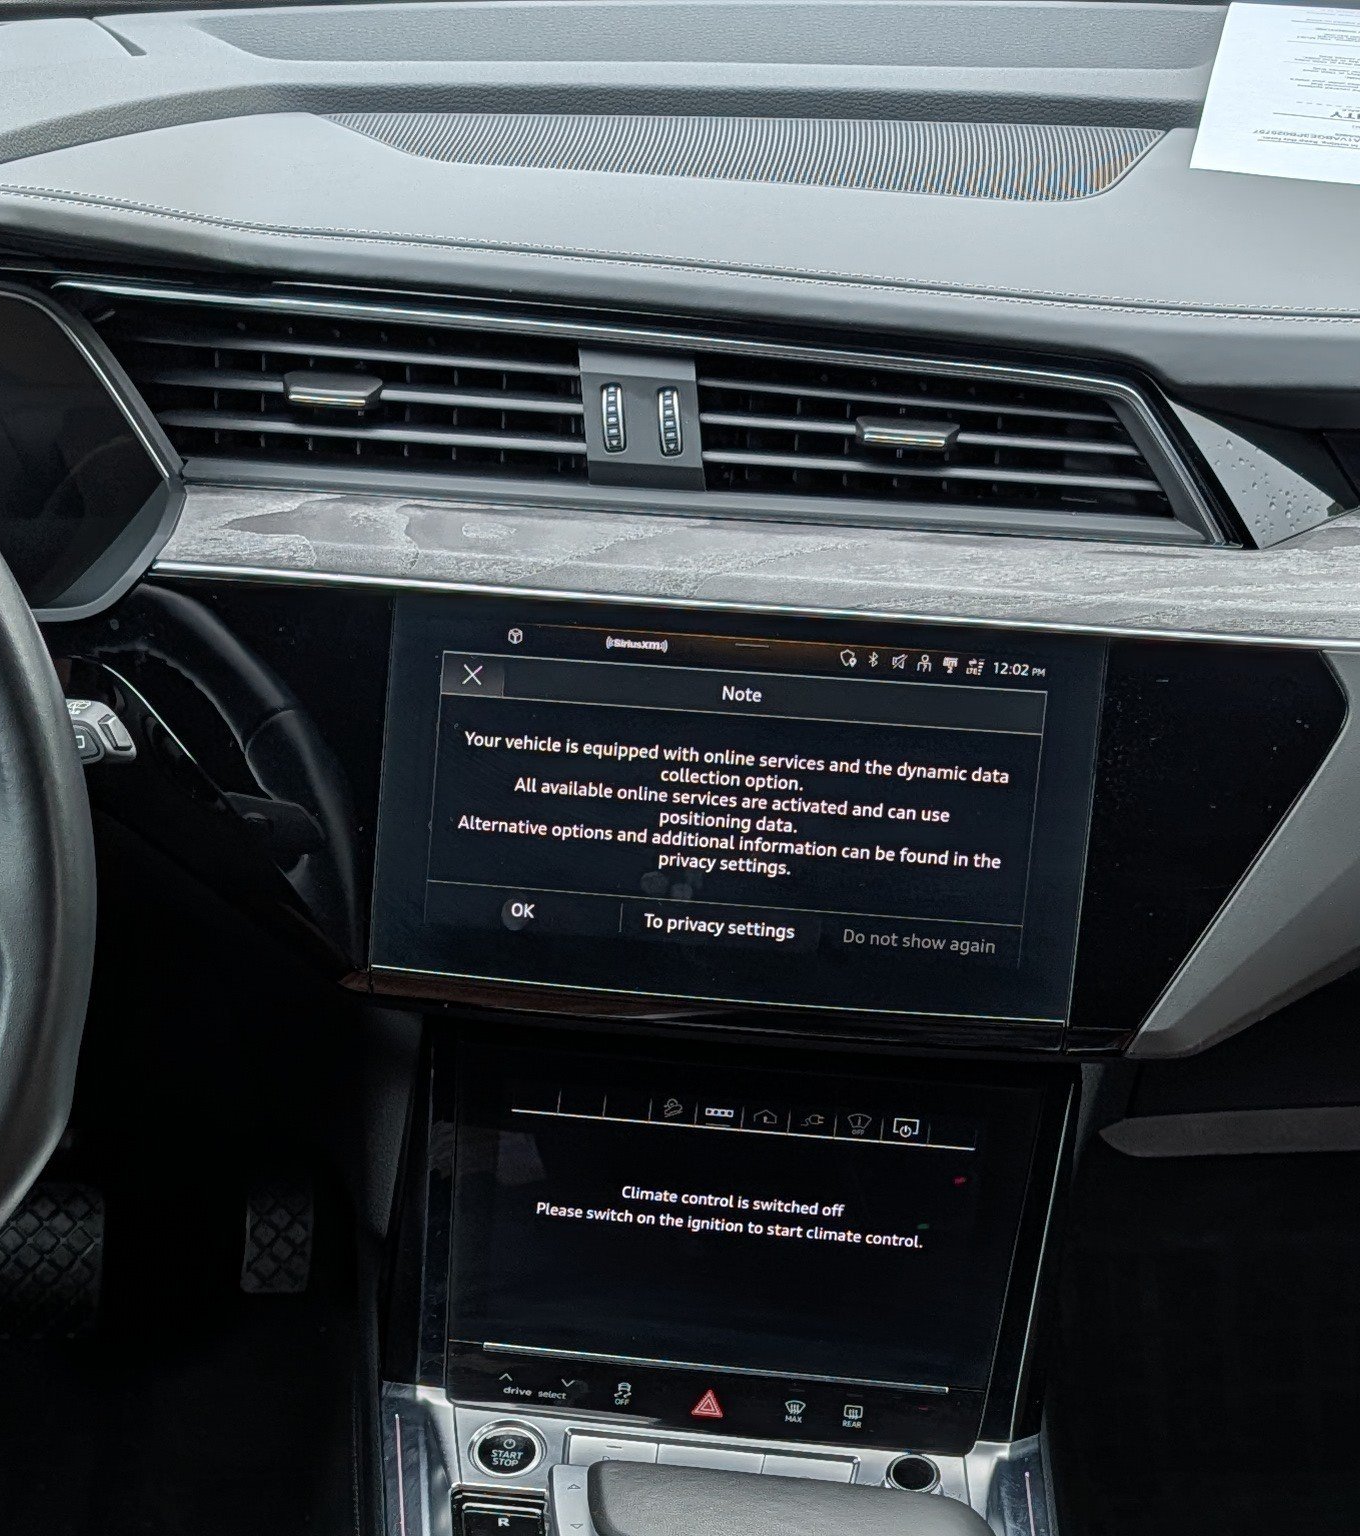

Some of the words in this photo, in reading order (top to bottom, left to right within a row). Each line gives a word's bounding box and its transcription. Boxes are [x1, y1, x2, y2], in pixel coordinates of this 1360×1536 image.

[993, 661, 1030, 677] 12:02
[1031, 667, 1046, 678] PM
[721, 685, 763, 703] Note
[464, 730, 502, 748] Your
[504, 734, 562, 753] vehicle
[565, 738, 579, 754] is
[582, 741, 660, 762] equipped
[662, 746, 700, 763] with
[703, 749, 756, 767] online
[758, 754, 825, 771] services
[828, 758, 861, 774] and
[864, 759, 893, 776] the
[896, 761, 968, 781] dynamic
[971, 766, 1010, 784] data
[660, 767, 741, 787] collection
[744, 774, 804, 792] option.
[513, 776, 537, 793] All
[540, 780, 614, 799] available
[616, 785, 669, 803] online
[672, 790, 738, 808] services
[741, 796, 768, 810] are
[771, 797, 848, 816] activated
[851, 802, 884, 818] and
[887, 807, 917, 821] can
[921, 809, 951, 823] use
[658, 810, 752, 834] positioning
[755, 815, 798, 834] data.
[457, 814, 548, 836] Alternative
[551, 823, 613, 841] options
[616, 828, 648, 844] and
[651, 829, 735, 850] additional
[738, 835, 838, 858] information
[841, 846, 871, 860] can
[874, 844, 896, 862] be
[899, 846, 950, 866] found
[953, 851, 969, 867] in
[972, 852, 1002, 869] the
[658, 852, 717, 874] privacy
[719, 857, 791, 878] settings.
[510, 902, 535, 919] OK
[643, 912, 664, 929] To
[666, 915, 725, 937] privacy
[727, 921, 795, 942] settings
[843, 928, 866, 944] Do
[870, 932, 899, 947] not
[902, 932, 947, 950] show
[949, 938, 996, 956] again
[621, 1185, 678, 1203] Climate
[681, 1193, 734, 1208] control
[737, 1195, 750, 1210] is
[752, 1198, 819, 1216] switched
[821, 1203, 846, 1217] off
[535, 1201, 584, 1219] Please
[585, 1208, 634, 1223] switch
[636, 1213, 656, 1225] on
[658, 1213, 684, 1228] the
[687, 1215, 744, 1233] ignition
[747, 1221, 764, 1235] to
[766, 1223, 804, 1239] start
[805, 1226, 862, 1243] climate
[865, 1234, 923, 1249] control.
[503, 1386, 533, 1397] drive
[538, 1391, 567, 1400] select
[785, 1414, 803, 1424] MAX
[842, 1419, 863, 1429] REAR
[491, 1449, 524, 1459] START
[492, 1457, 520, 1467] STOP
[497, 1517, 510, 1527] R
